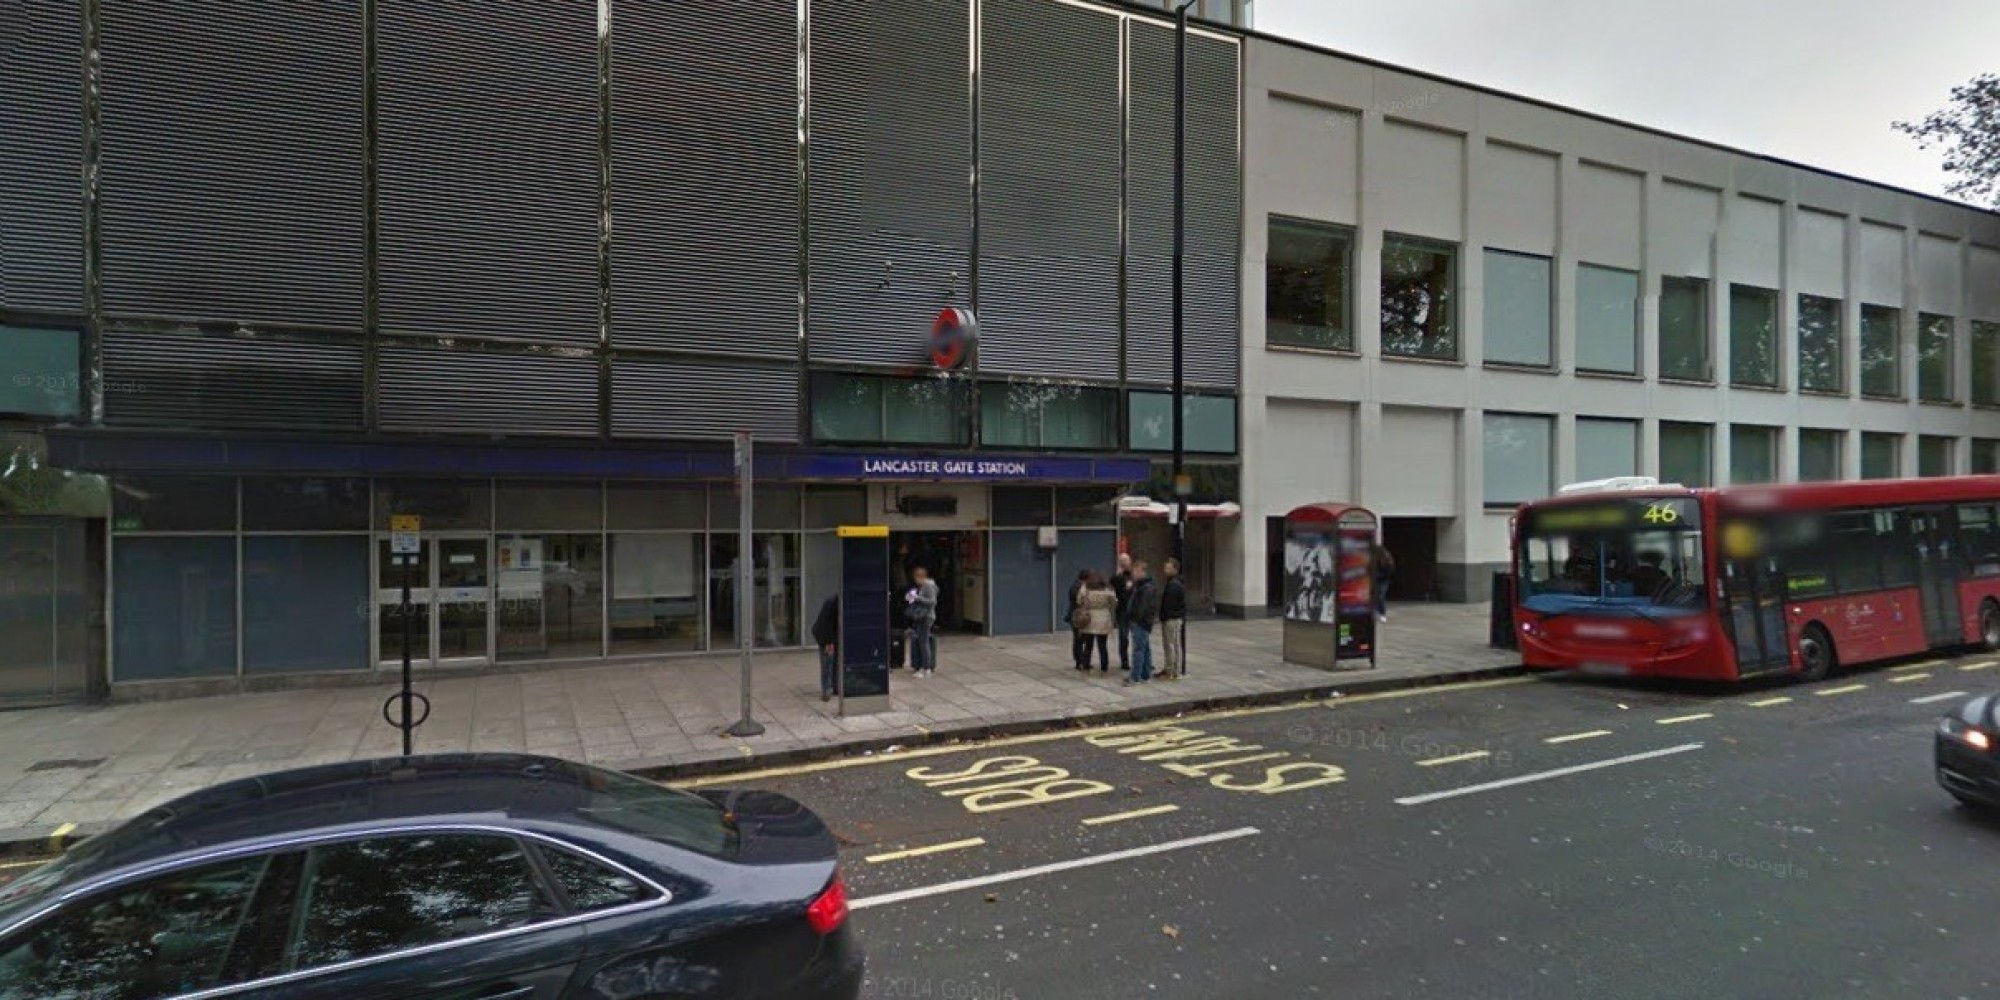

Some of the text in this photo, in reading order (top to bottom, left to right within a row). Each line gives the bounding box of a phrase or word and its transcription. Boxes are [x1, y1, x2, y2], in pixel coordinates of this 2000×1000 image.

[864, 460, 1026, 475] LANCASTER GATE STATION
[1643, 503, 1678, 524] 46
[1084, 725, 1347, 794] STAND
[905, 755, 1115, 814] BUS
